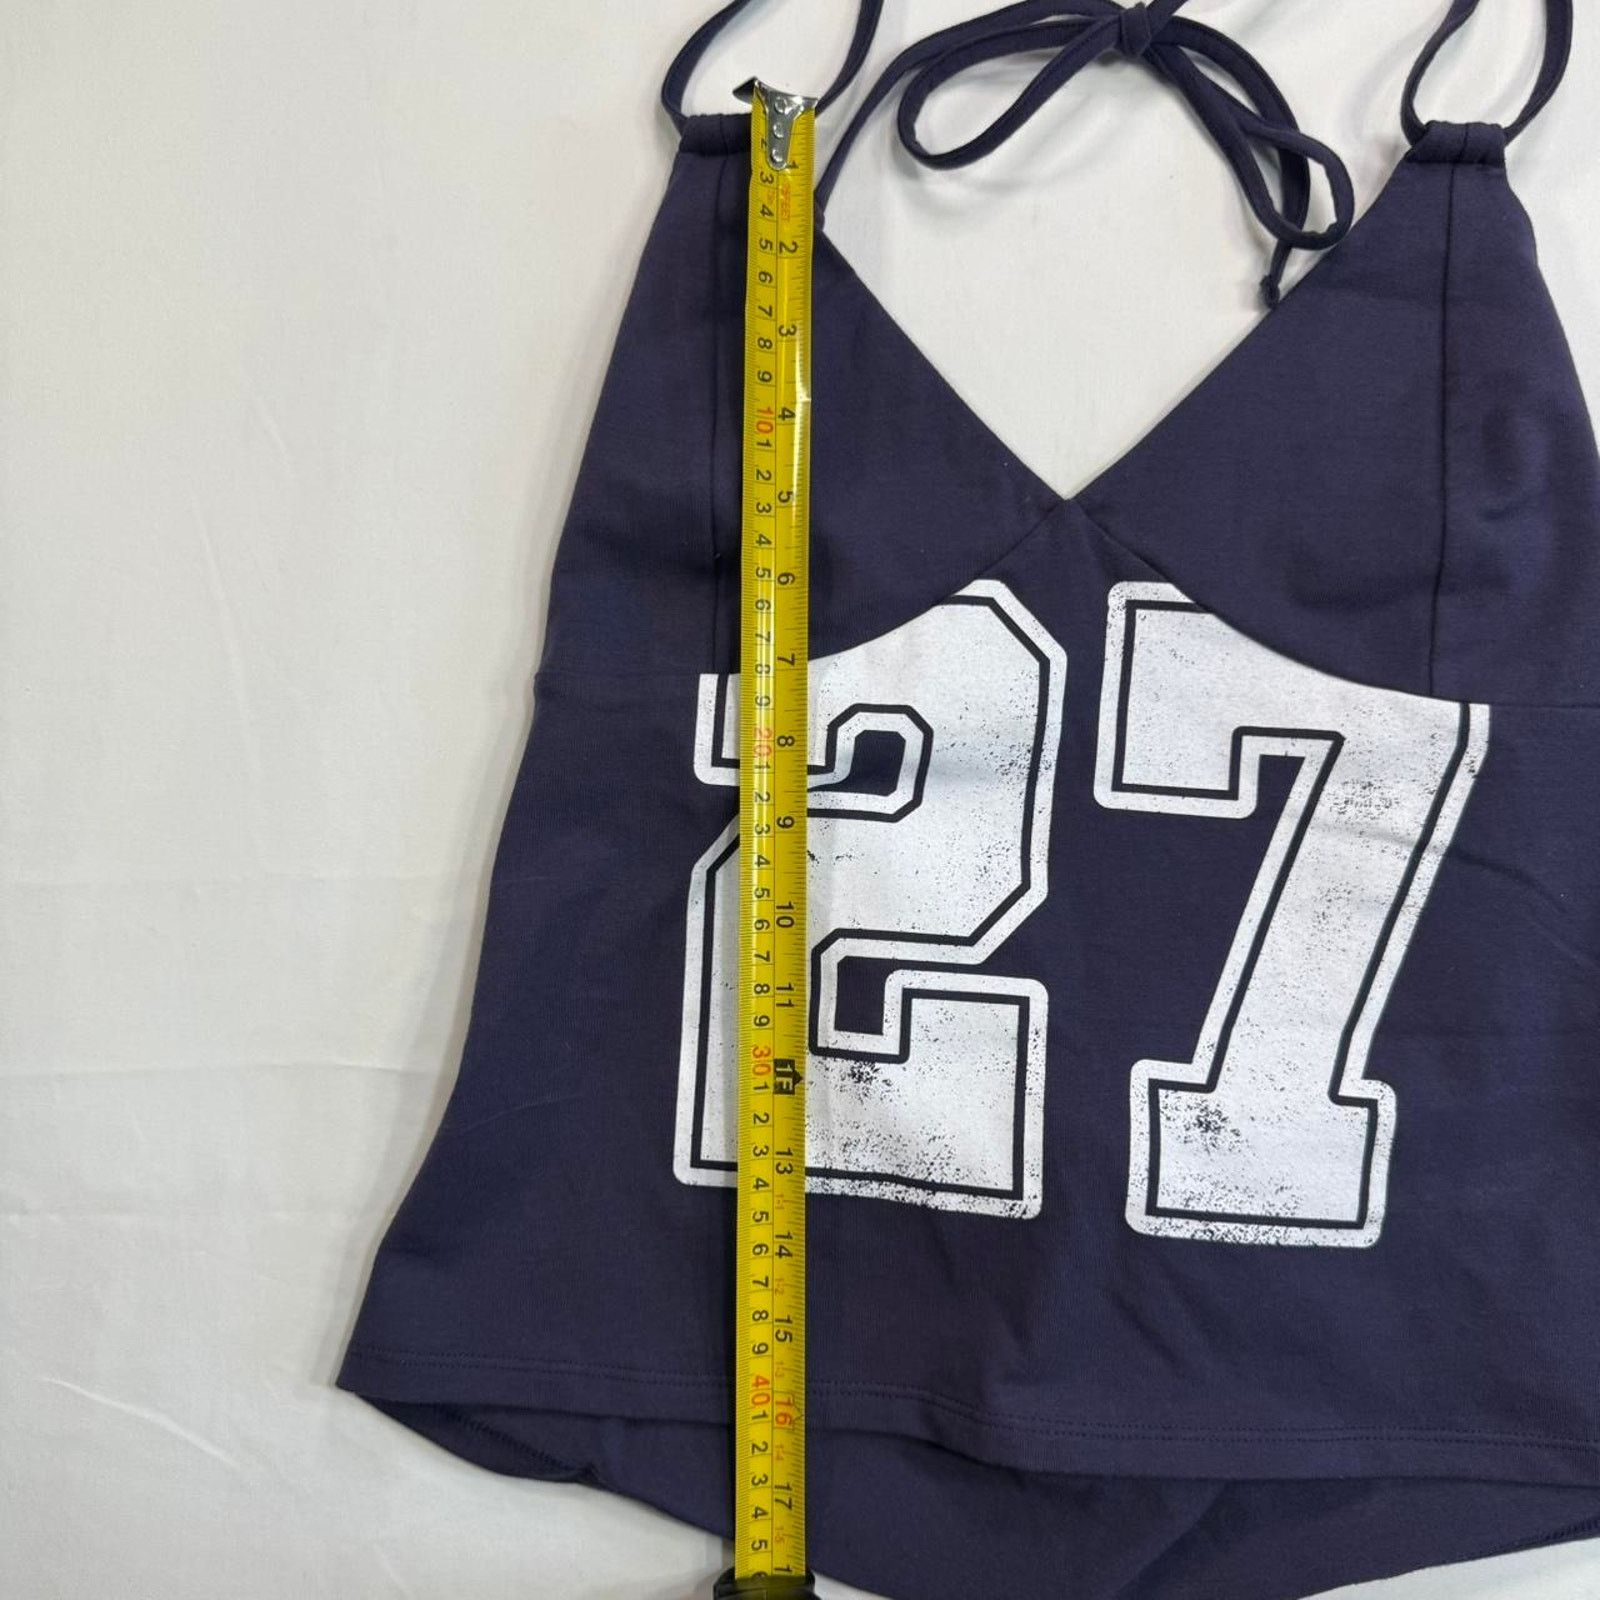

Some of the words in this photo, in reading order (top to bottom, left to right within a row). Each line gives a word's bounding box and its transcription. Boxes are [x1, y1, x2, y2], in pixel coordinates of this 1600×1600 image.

[760, 171, 774, 185] 3
[760, 204, 774, 217] 4
[759, 238, 773, 250] 5
[779, 241, 799, 254] 2
[758, 271, 773, 284] 6
[758, 305, 773, 317] 7
[778, 324, 796, 337] 3
[758, 337, 773, 350] 8
[757, 371, 772, 383] 9
[756, 406, 774, 434] 10
[778, 407, 796, 421] 4
[756, 440, 772, 449] 1
[756, 469, 772, 481] 2
[778, 490, 793, 503] 5
[756, 502, 772, 514] 3
[756, 534, 772, 546] 4
[756, 567, 771, 579] 5
[777, 572, 795, 585] 6
[755, 599, 771, 611] 6
[755, 631, 770, 643] 7
[777, 653, 795, 666] 7
[755, 663, 770, 674] 8
[755, 695, 770, 707] 9
[754, 727, 773, 758] 20
[777, 735, 795, 747] 8
[755, 792, 770, 803] 2
[776, 816, 795, 829] 9
[755, 824, 770, 835] 3
[755, 855, 770, 867] 4
[754, 887, 770, 898] 5
[673, 579, 1490, 1248] 27
[776, 901, 794, 928] 10
[754, 919, 770, 931] 6
[754, 951, 770, 962] 7
[754, 983, 770, 994] 8
[776, 982, 794, 1008] 11
[754, 1015, 770, 1027] 9
[752, 1046, 771, 1076] 30
[753, 1082, 769, 1090] 1
[753, 1113, 769, 1124] 2
[752, 1145, 769, 1157] 3
[775, 1147, 793, 1175] 13
[752, 1178, 769, 1190] 4
[752, 1211, 769, 1223] 5
[752, 1244, 769, 1256] 6
[775, 1230, 793, 1259] 14
[752, 1276, 769, 1288] 7
[752, 1310, 769, 1322] 8
[775, 1314, 793, 1343] 15
[752, 1343, 768, 1354] 9
[751, 1375, 770, 1406] 40
[752, 1410, 768, 1420] 1
[775, 1396, 793, 1426] 16
[752, 1441, 768, 1455] 2
[751, 1474, 768, 1486] 3
[774, 1482, 793, 1510] 17
[752, 1506, 768, 1519] 4
[751, 1539, 767, 1551] 5
